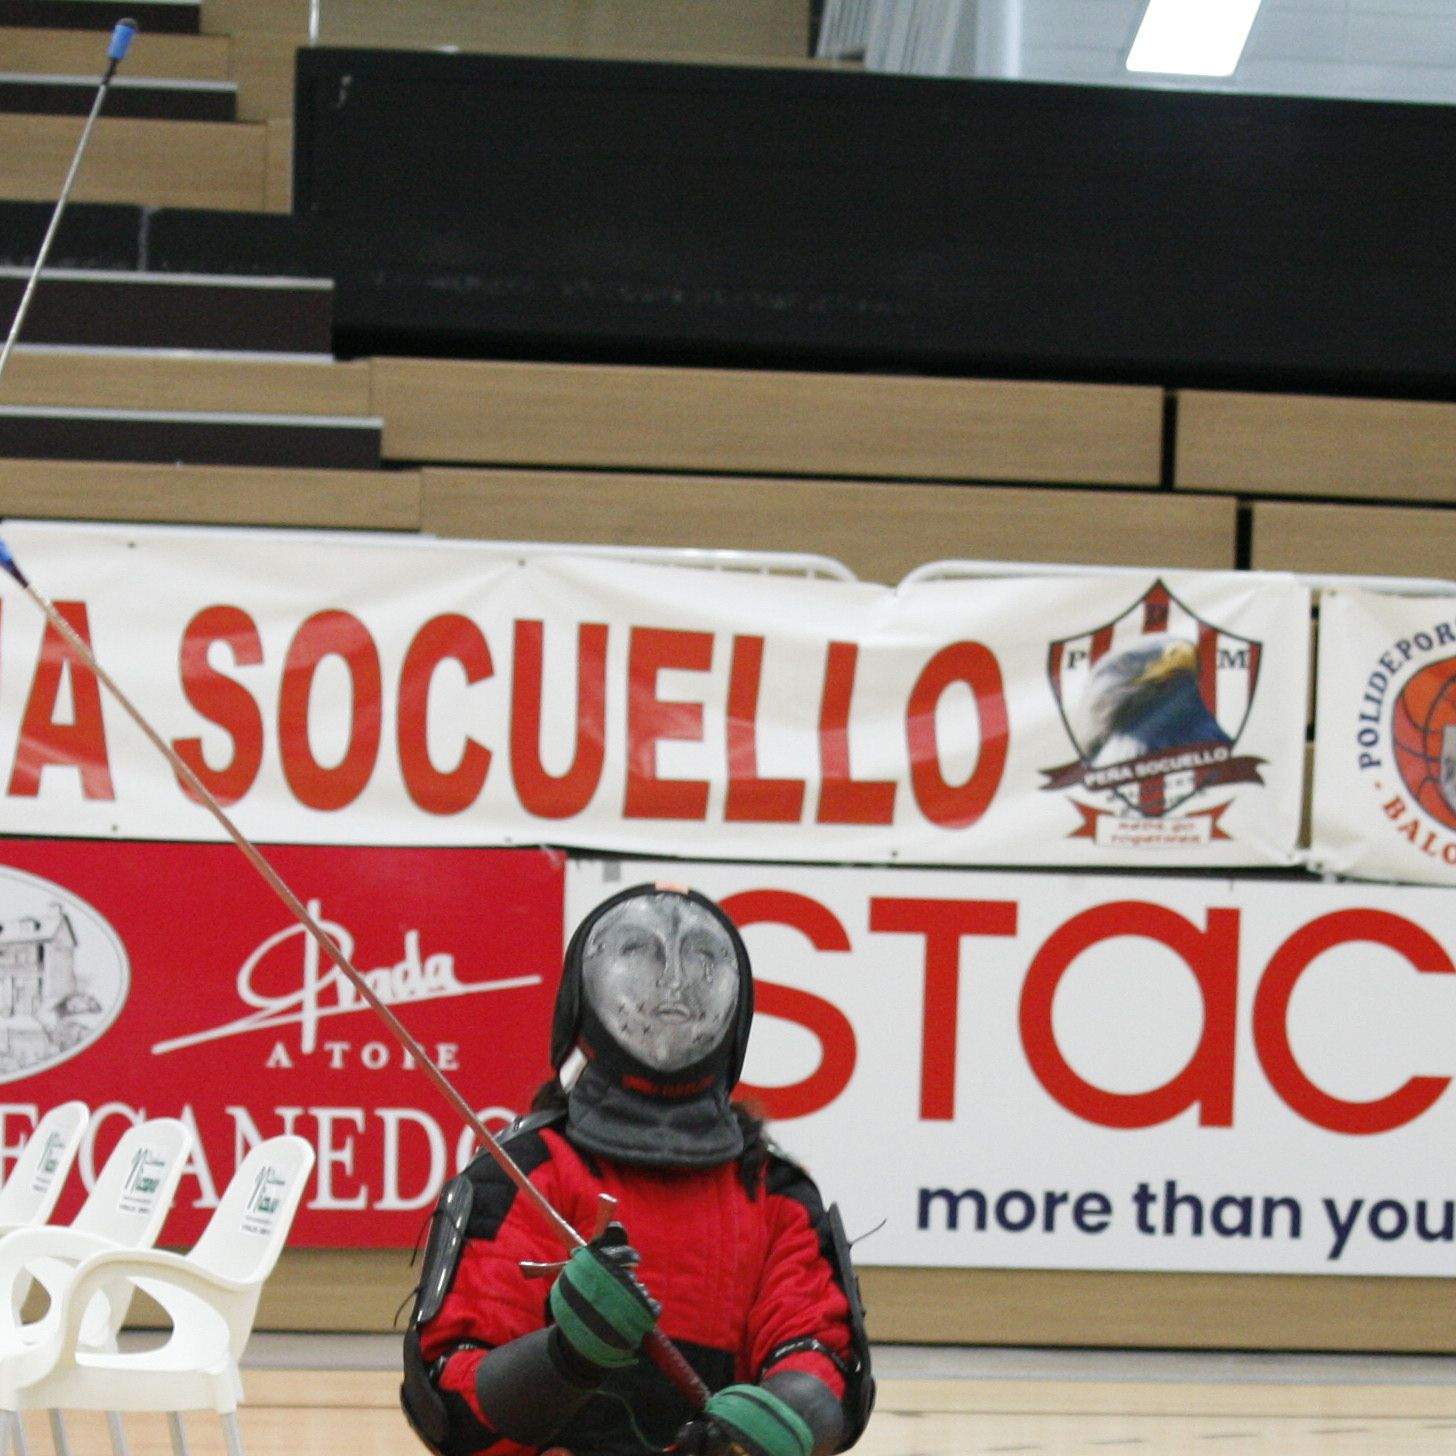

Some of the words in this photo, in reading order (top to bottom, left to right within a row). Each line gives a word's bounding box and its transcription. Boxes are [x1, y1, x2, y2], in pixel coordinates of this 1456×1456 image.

[1218, 649, 1249, 669] M
[172, 604, 1010, 830] SOCUELLO
[265, 1042, 293, 1069] A
[917, 1187, 1112, 1234] more
[1132, 1180, 1302, 1239] than
[1323, 1197, 1456, 1260] you
